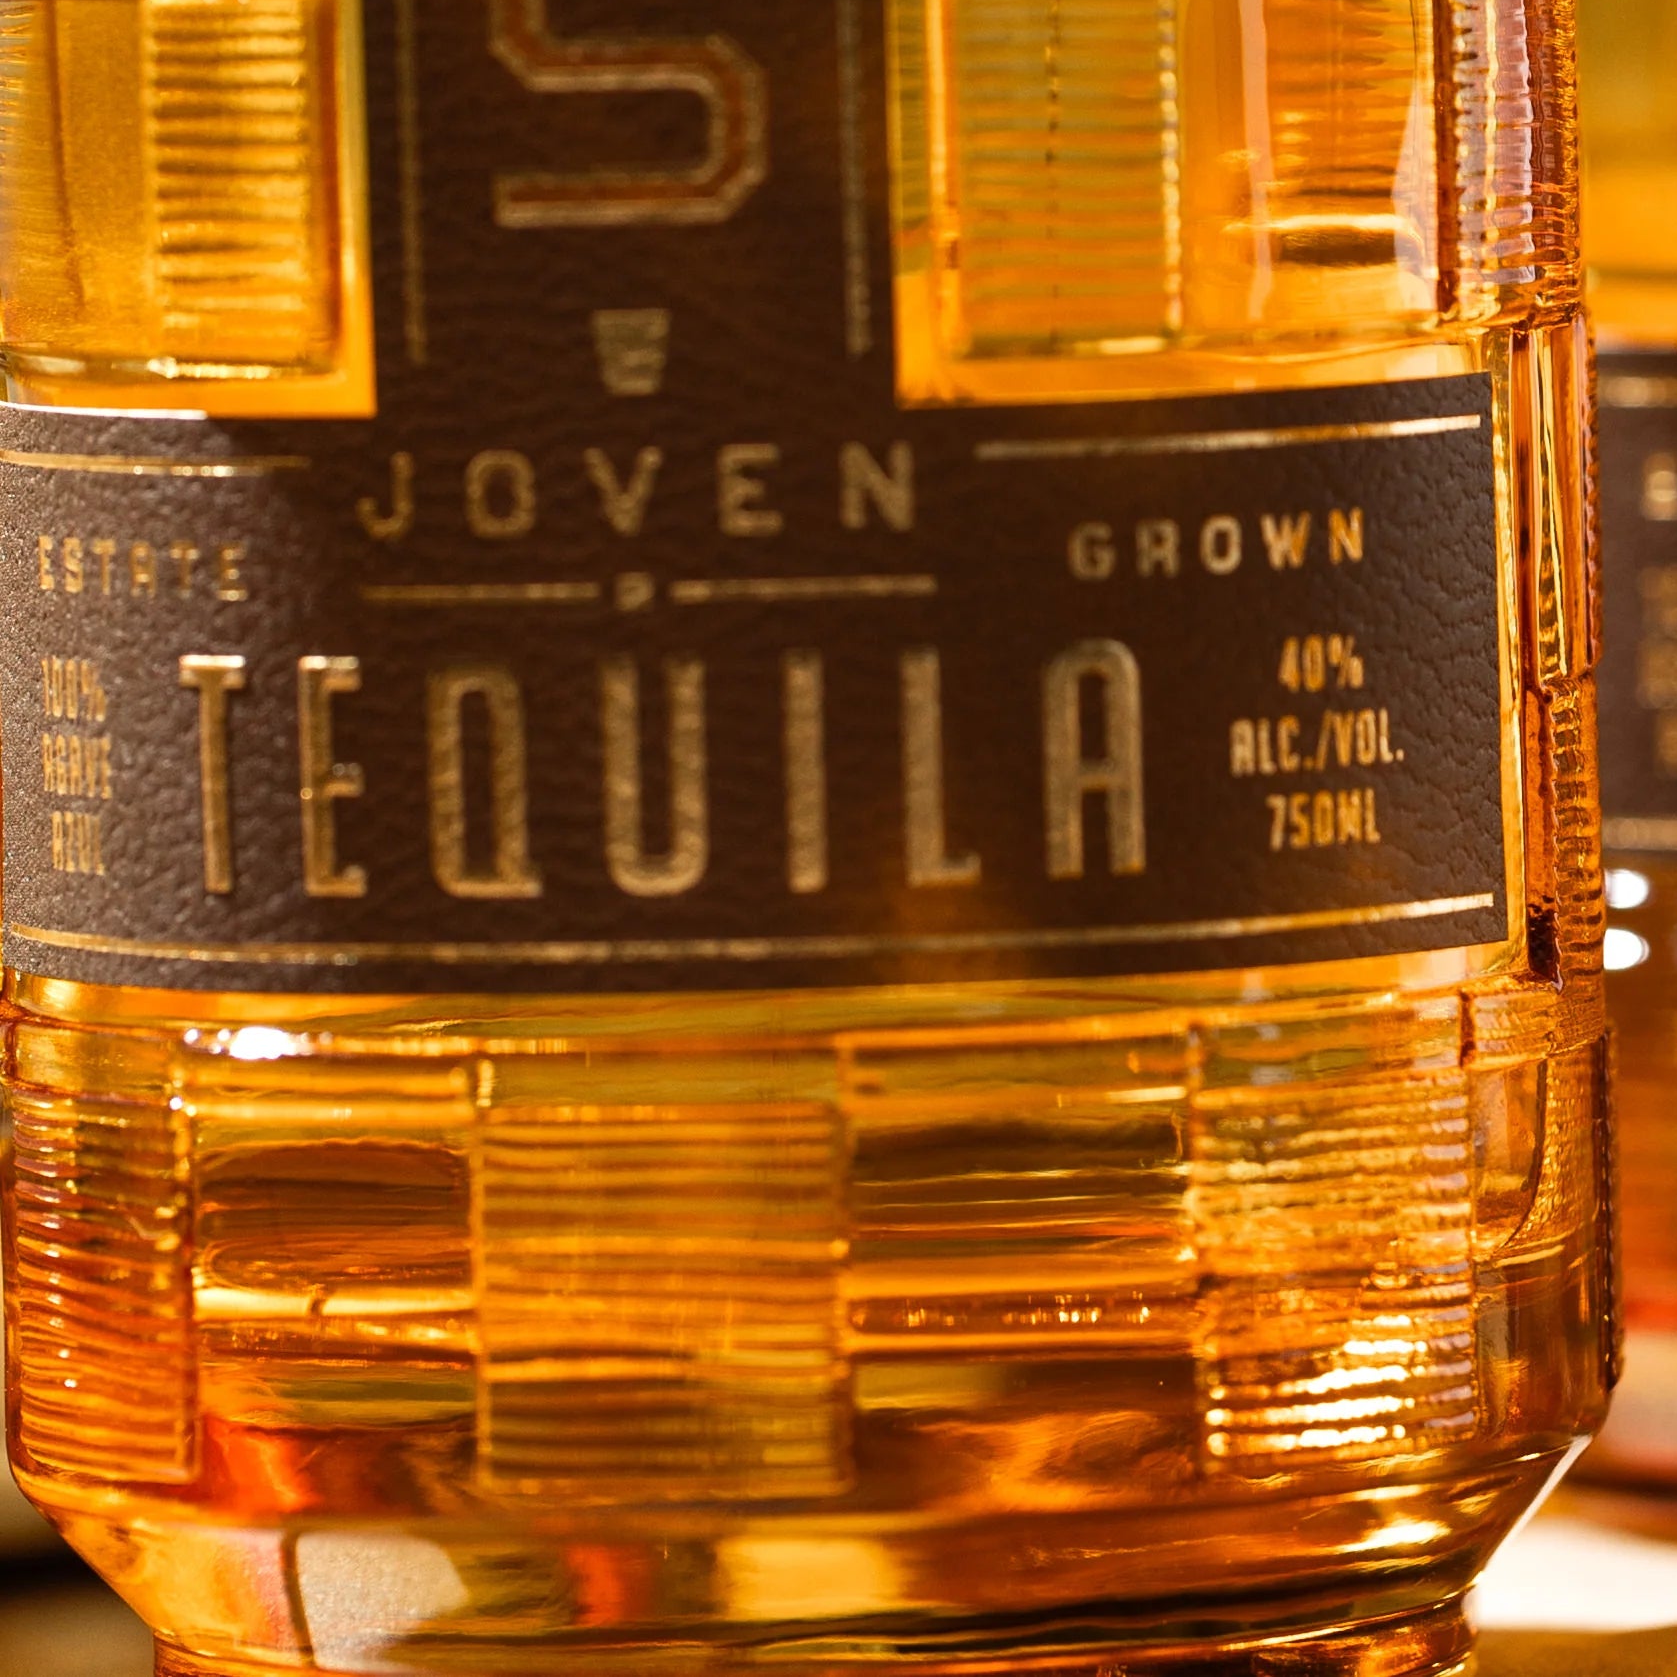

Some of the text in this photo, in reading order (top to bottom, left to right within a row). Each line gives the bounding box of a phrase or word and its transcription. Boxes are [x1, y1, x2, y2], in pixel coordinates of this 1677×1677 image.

[357, 439, 914, 538] JOVEN
[39, 509, 1364, 601] ESTATE GROWN
[1278, 634, 1364, 692] 40%
[180, 639, 1146, 898] TEQUILA
[1230, 707, 1405, 777] ALC./VOL.
[1266, 789, 1381, 852] 750ML
